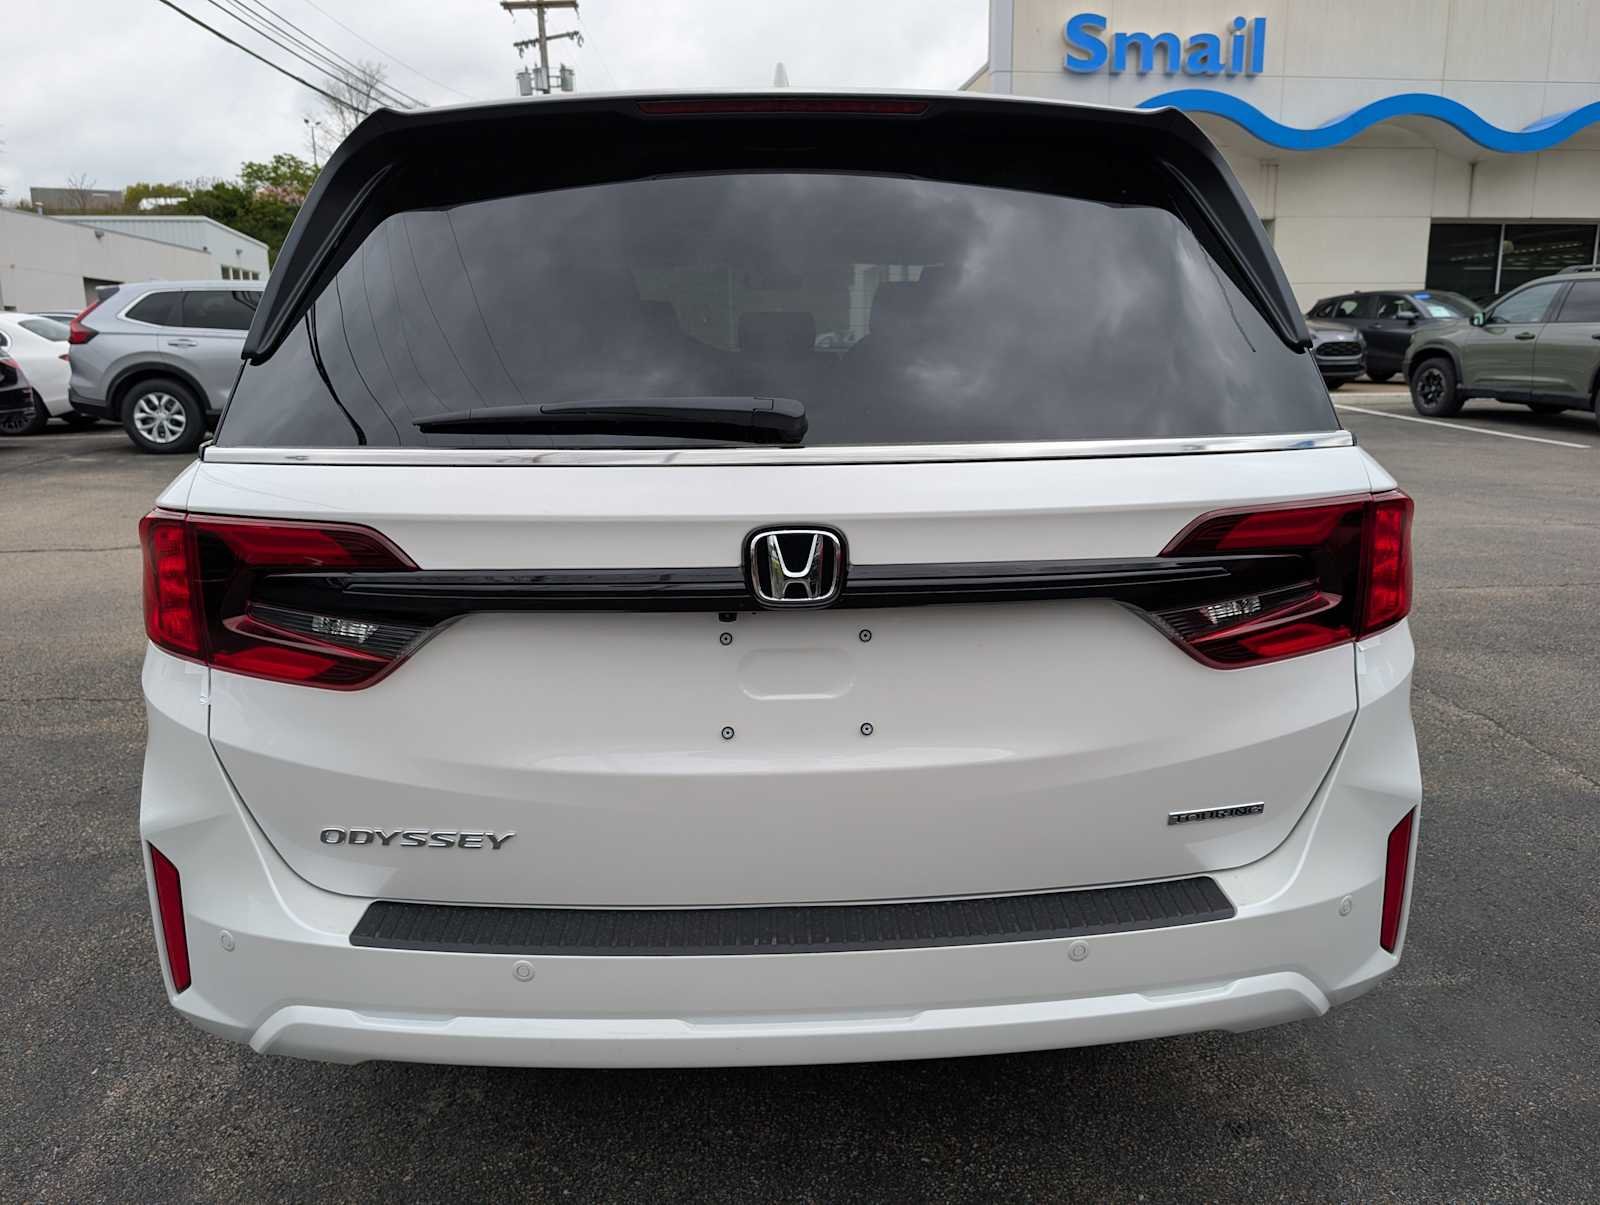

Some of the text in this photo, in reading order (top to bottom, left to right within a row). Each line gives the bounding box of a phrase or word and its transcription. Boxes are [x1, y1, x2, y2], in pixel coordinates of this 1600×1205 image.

[1064, 12, 1266, 75] Smail
[1169, 803, 1264, 825] TOURING
[320, 827, 516, 850] ODYSSEY
